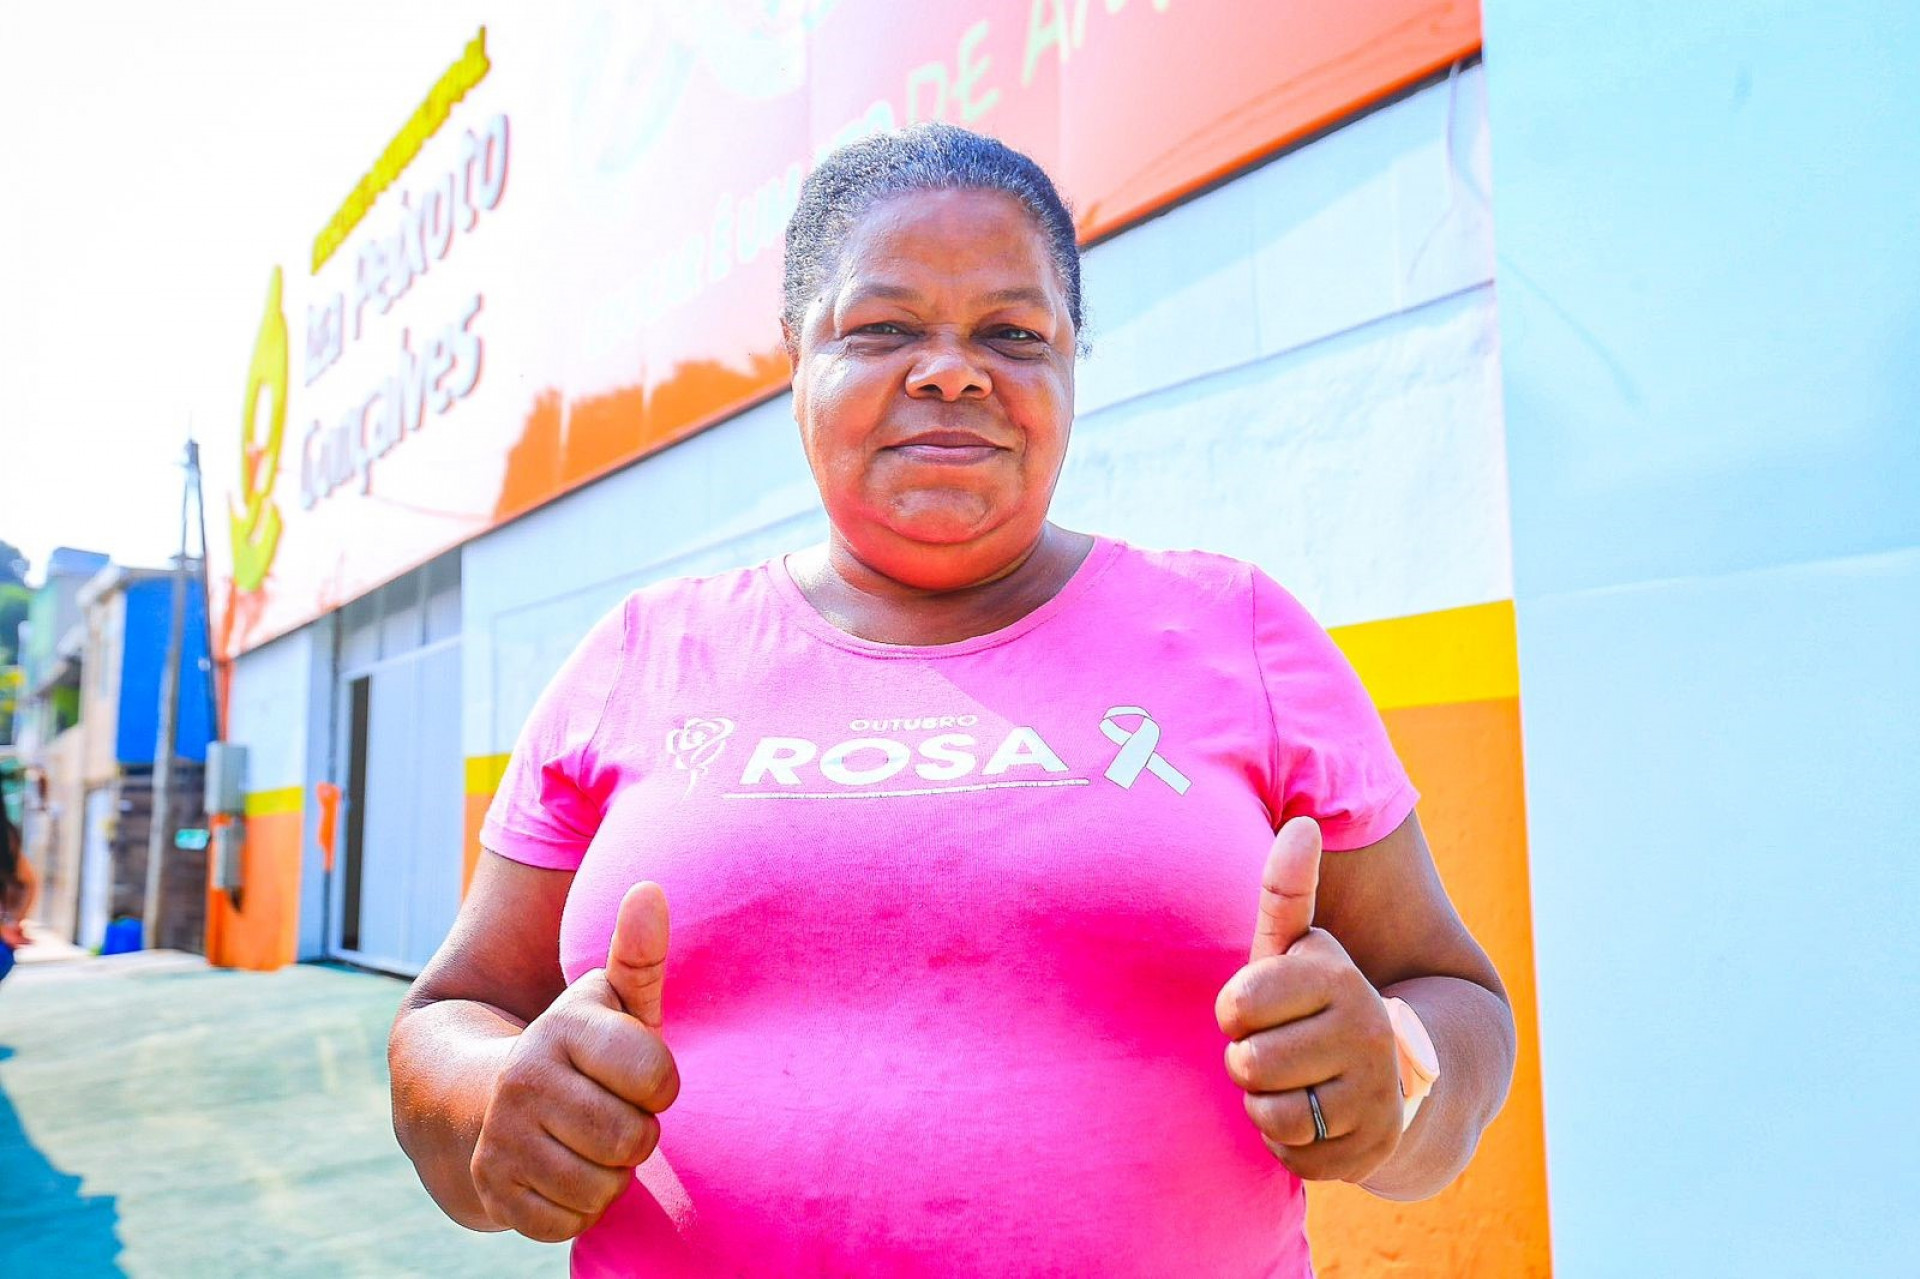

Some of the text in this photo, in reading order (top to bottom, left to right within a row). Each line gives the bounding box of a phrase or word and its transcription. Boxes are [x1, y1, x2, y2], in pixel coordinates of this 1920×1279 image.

[907, 20, 1000, 123] DE
[355, 114, 509, 340] Peixoto
[301, 294, 484, 511] Gonçalves
[739, 726, 1069, 785] ROSA
[850, 714, 978, 731] OUTUBRO
